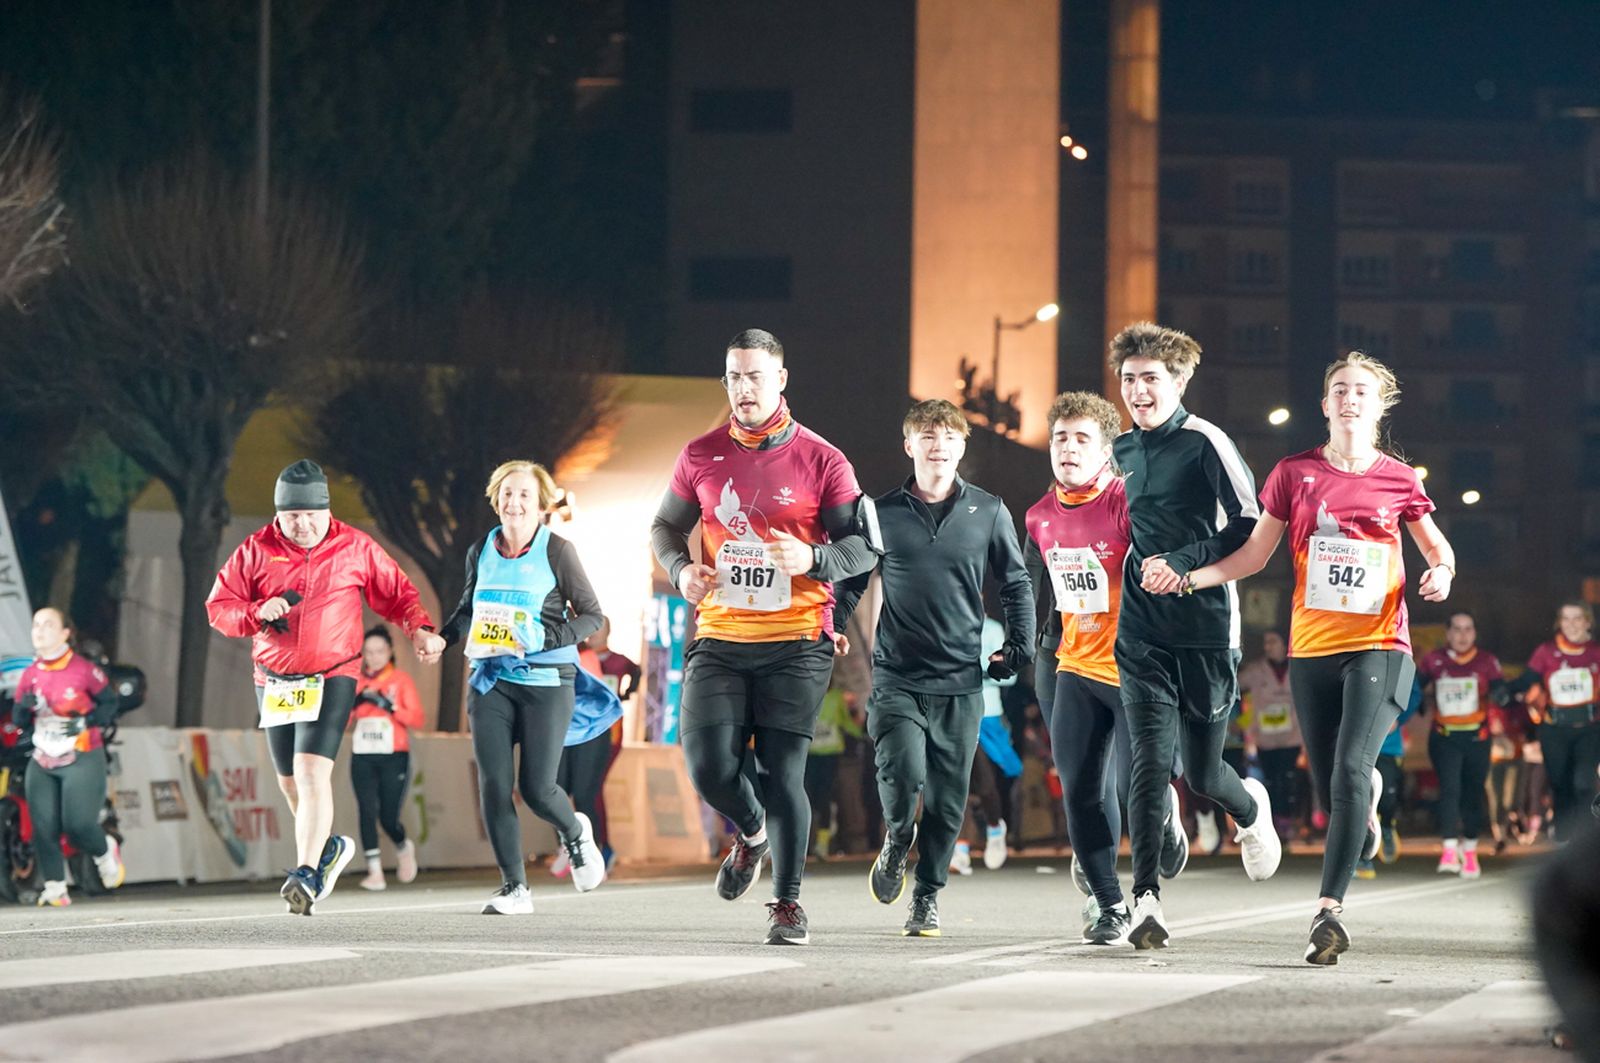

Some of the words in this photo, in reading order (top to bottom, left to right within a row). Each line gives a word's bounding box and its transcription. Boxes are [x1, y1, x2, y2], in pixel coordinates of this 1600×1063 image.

[728, 516, 747, 536] 43
[732, 547, 753, 557] NOCHE
[1318, 553, 1332, 562] SAN
[1327, 546, 1350, 555] NOCHE
[723, 555, 737, 564] SAN
[730, 565, 775, 588] 3167
[1061, 571, 1098, 592] 1546
[1328, 564, 1366, 588] 542
